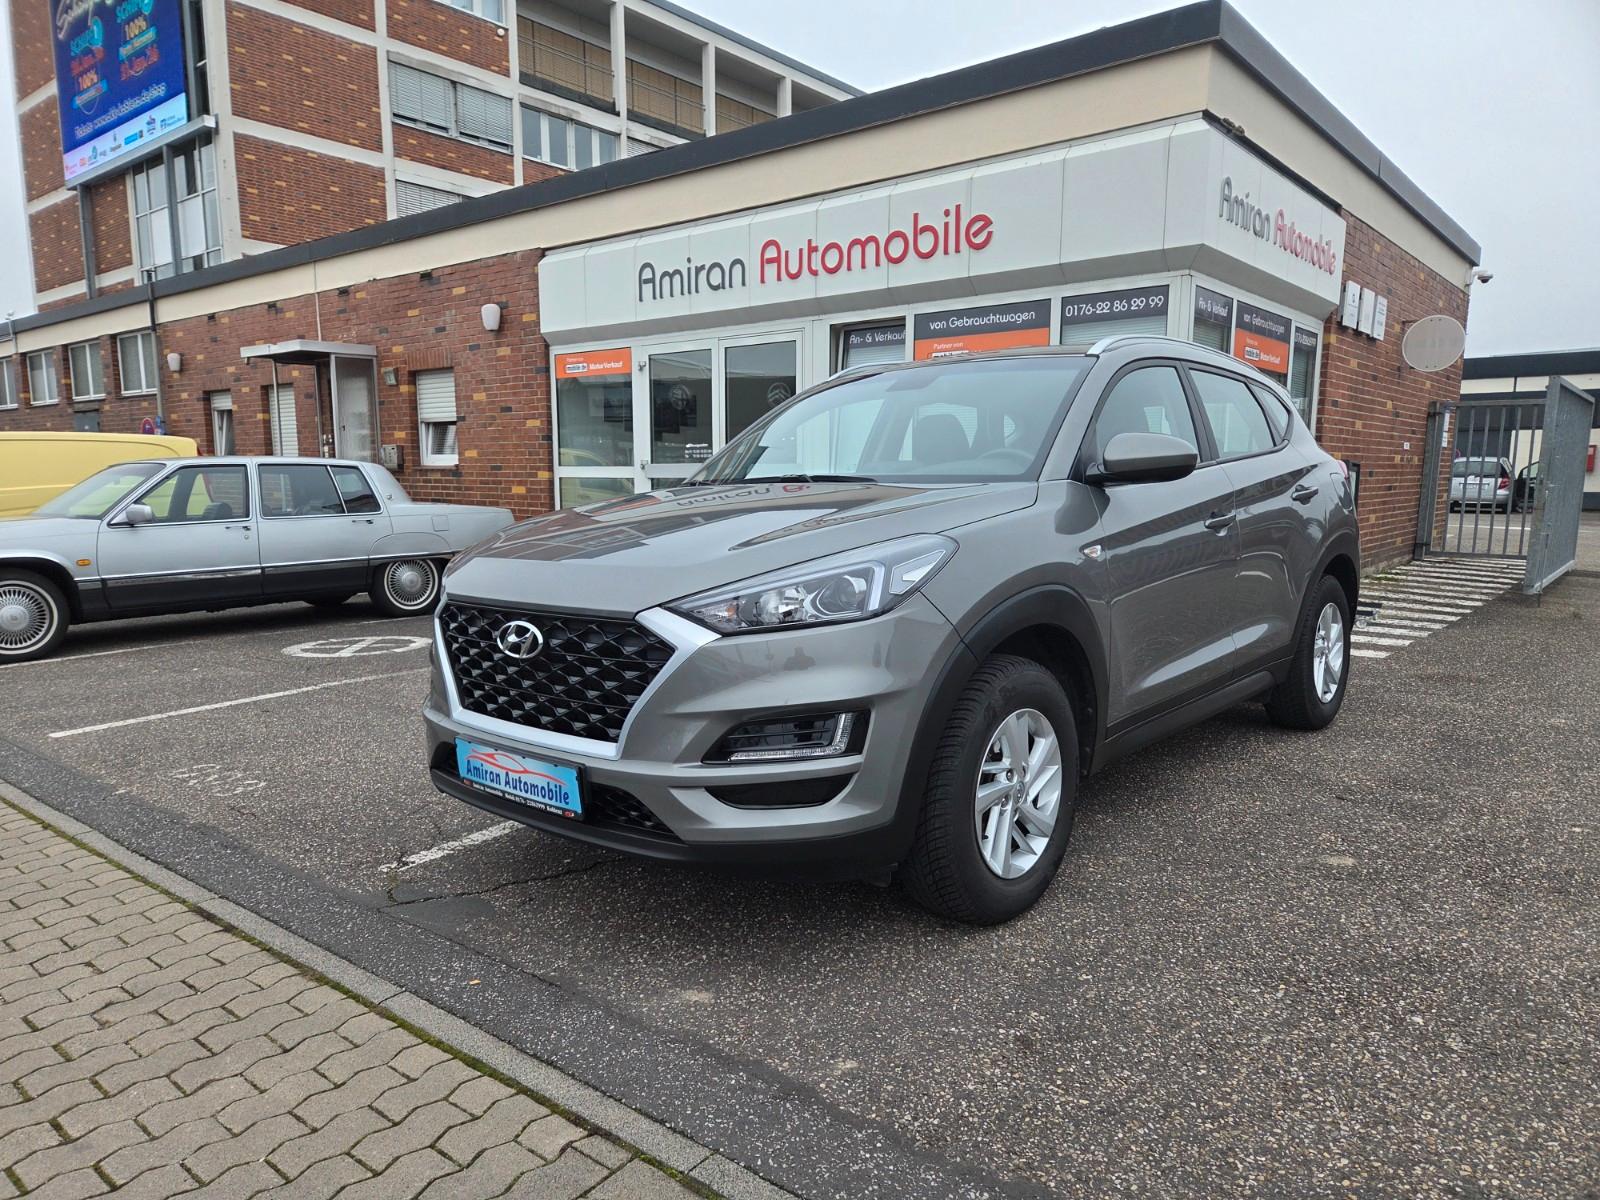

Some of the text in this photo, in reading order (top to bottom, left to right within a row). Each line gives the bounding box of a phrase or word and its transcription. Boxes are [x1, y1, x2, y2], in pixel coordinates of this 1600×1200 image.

[1218, 176, 1336, 276] Amiran Automobile
[638, 203, 994, 303] Amiran Automobile
[929, 311, 1036, 330] von Gebrauchtwagen
[1065, 295, 1164, 317] 0176-22 86 29 99
[865, 332, 873, 343] &
[466, 759, 501, 786] Amiran
[504, 771, 570, 806] Automobile
